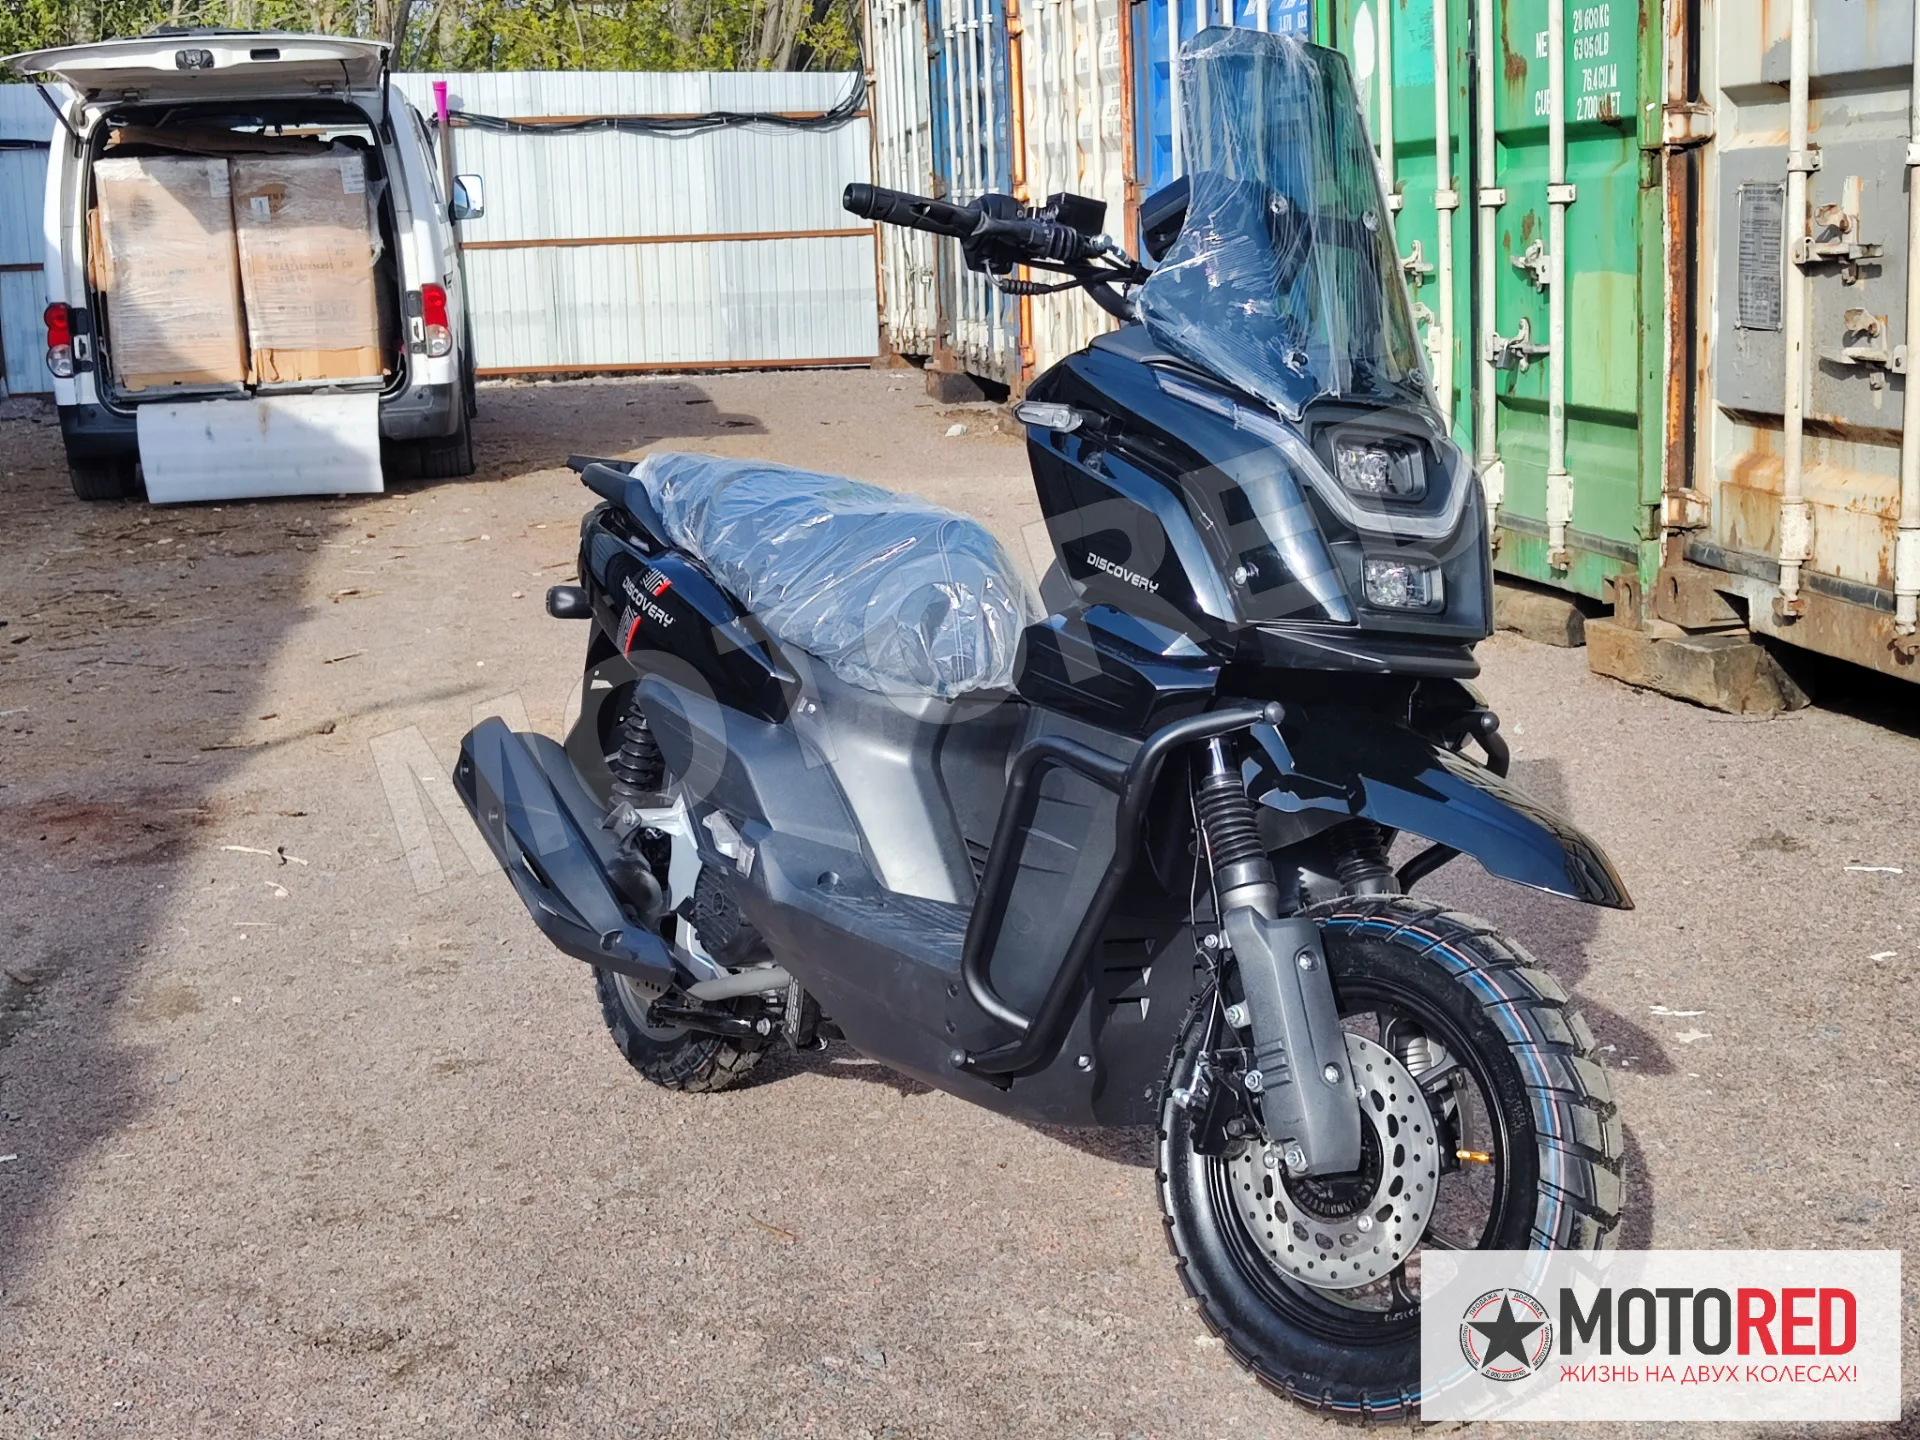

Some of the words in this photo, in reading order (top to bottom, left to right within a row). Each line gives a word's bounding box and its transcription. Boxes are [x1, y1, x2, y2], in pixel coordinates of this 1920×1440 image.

[1535, 31, 1549, 58] NE
[1086, 552, 1160, 594] DISCOVERY
[622, 575, 674, 628] DISCOVERY
